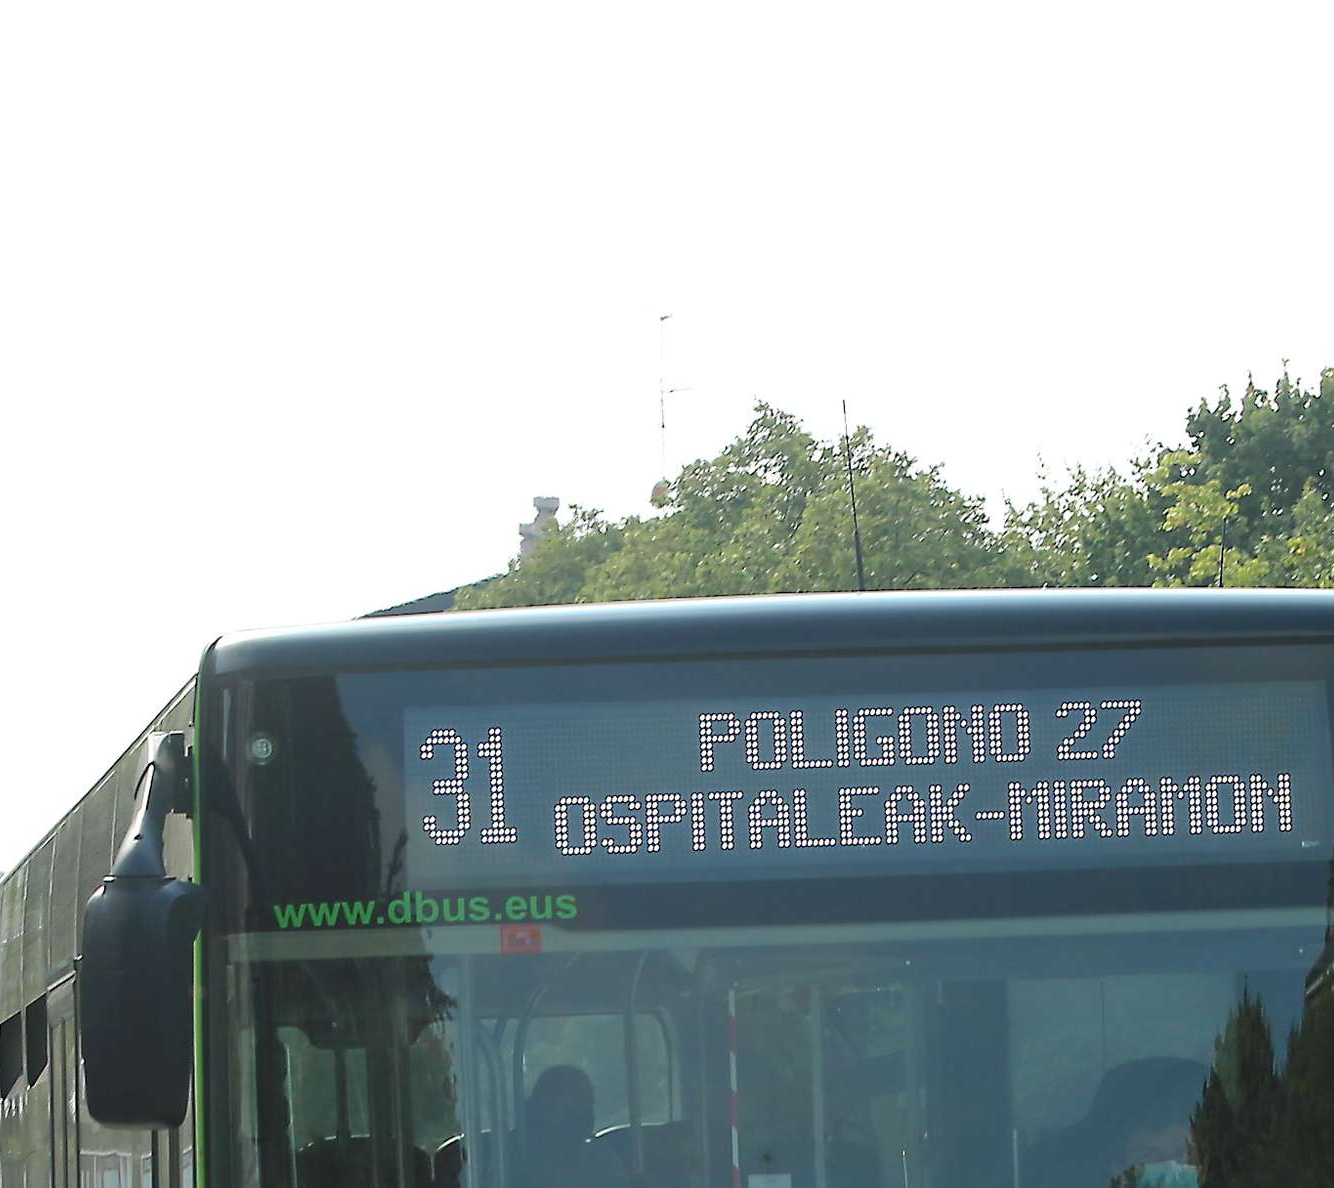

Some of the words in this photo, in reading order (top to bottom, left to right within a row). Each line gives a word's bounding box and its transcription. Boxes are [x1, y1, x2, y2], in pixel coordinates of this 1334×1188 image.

[699, 704, 1029, 772] POLIGONO
[1056, 700, 1141, 759] 27
[419, 728, 517, 845] 31
[554, 774, 1292, 856] OSPITALEAK-MIRAMON
[274, 891, 578, 929] www.dbus.eus
